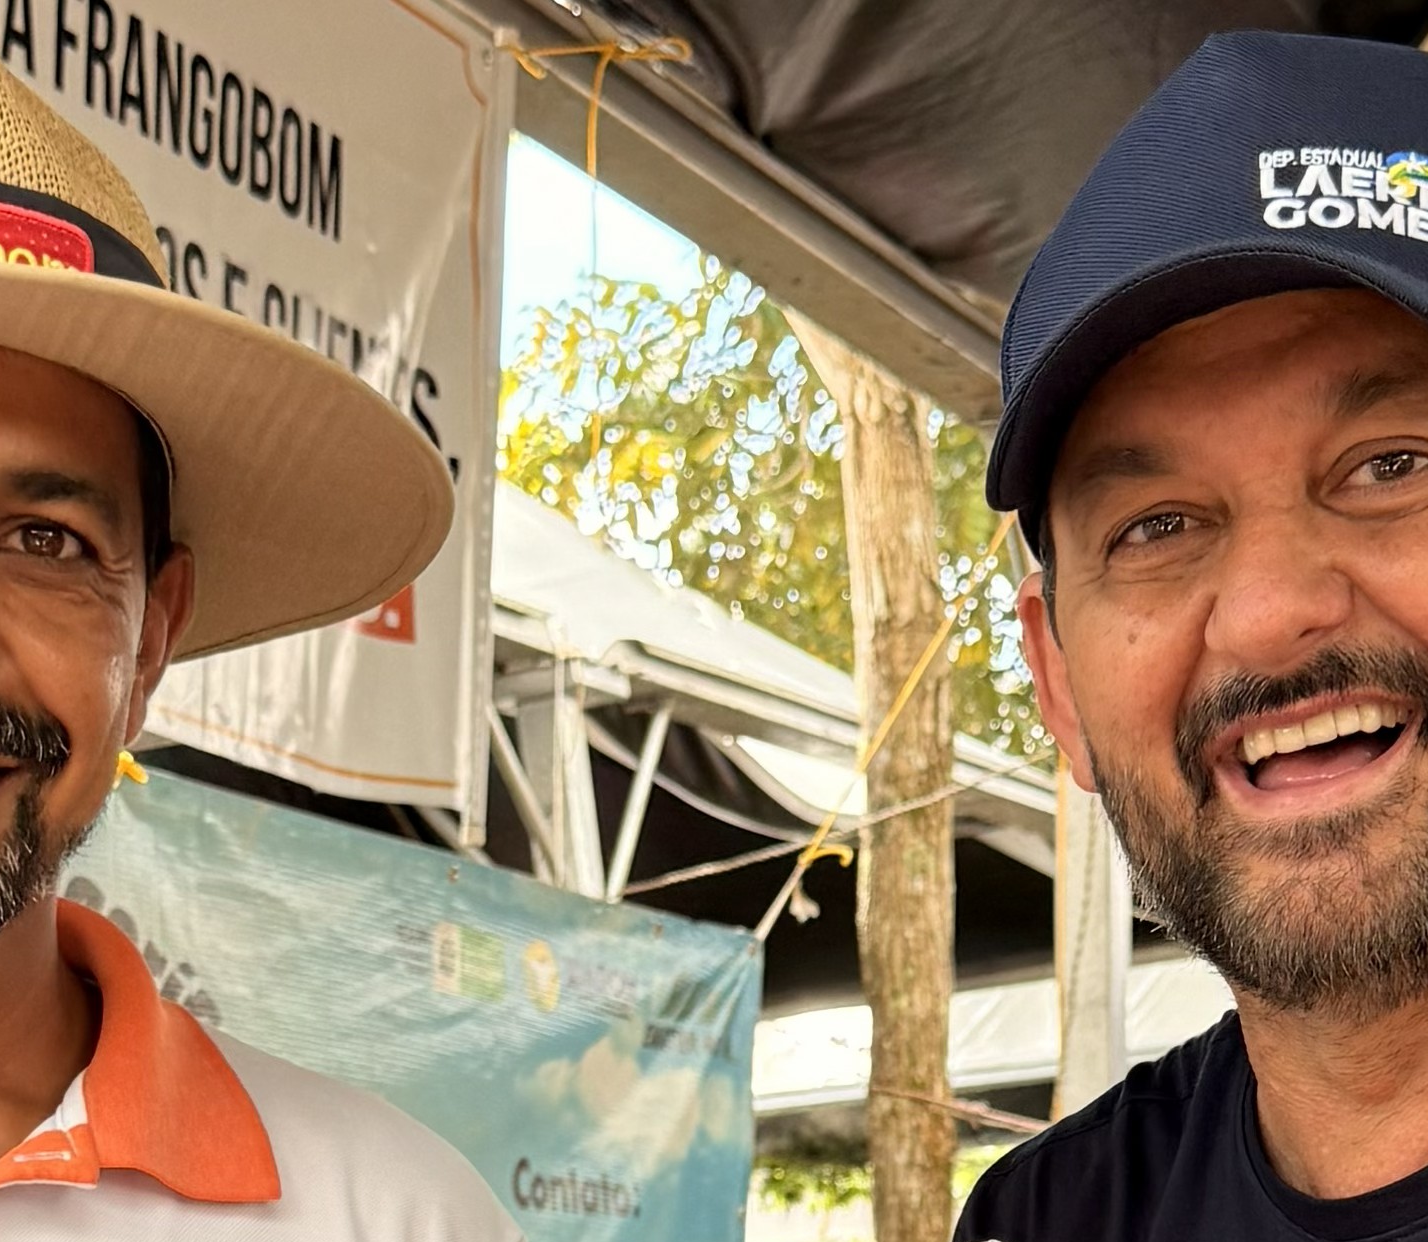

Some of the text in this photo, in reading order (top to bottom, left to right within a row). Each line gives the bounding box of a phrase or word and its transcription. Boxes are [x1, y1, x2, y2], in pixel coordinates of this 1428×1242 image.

[54, 0, 343, 241] FRANGOBOM
[1259, 147, 1388, 170] DEP. ESTADUAL
[512, 1157, 641, 1218] Contato:
